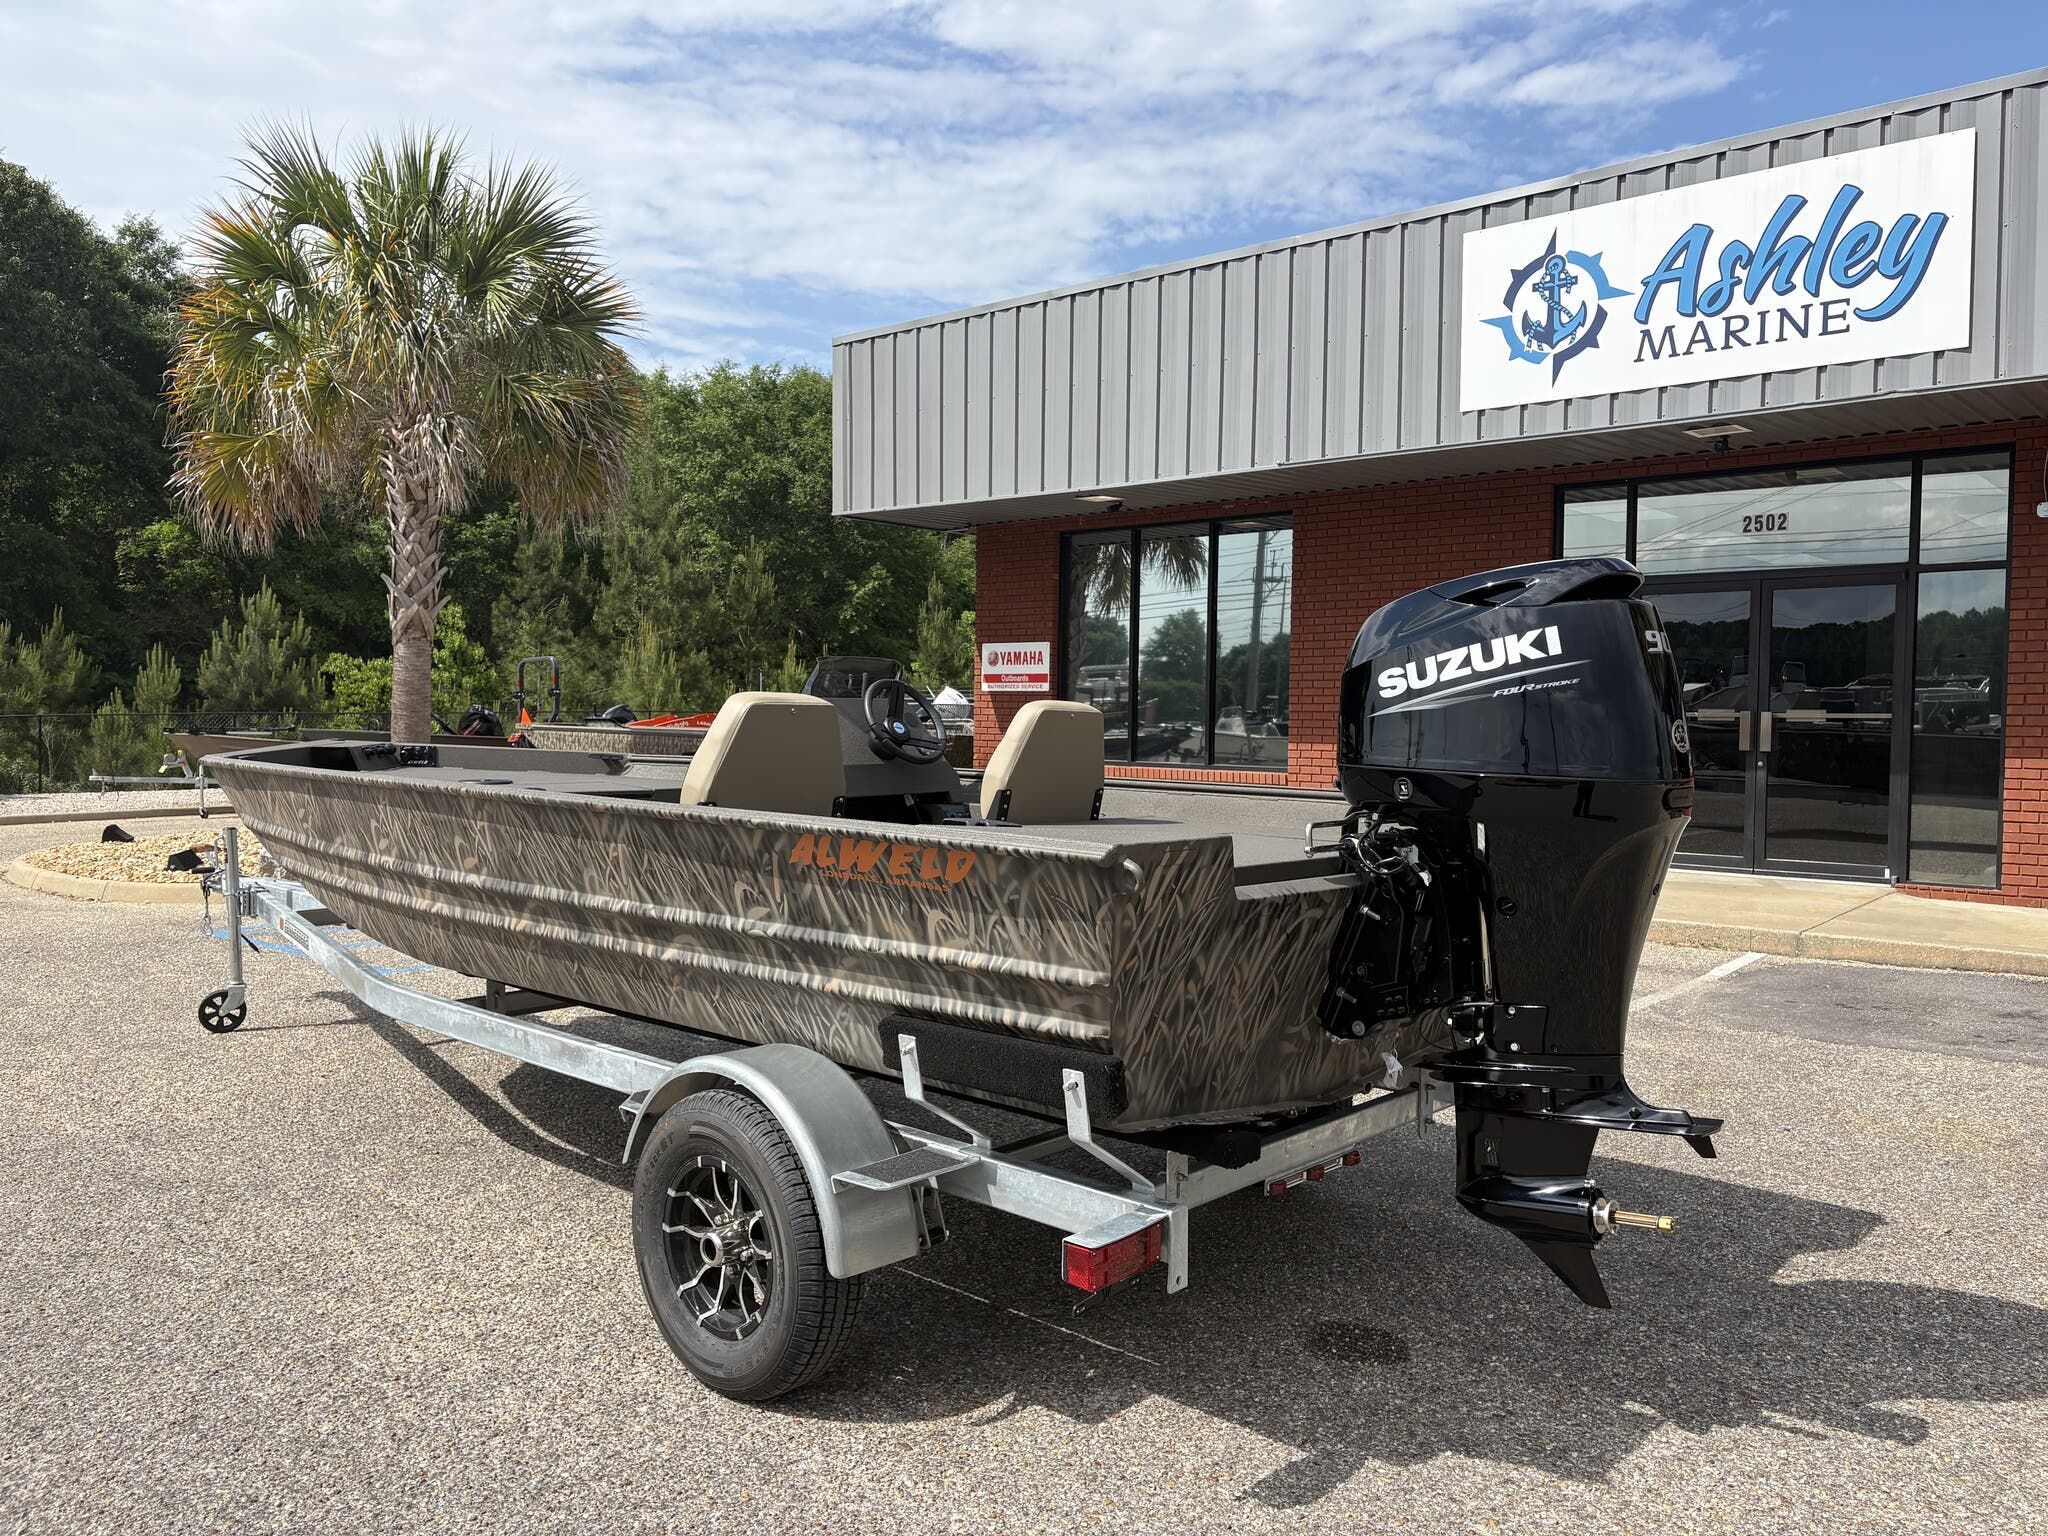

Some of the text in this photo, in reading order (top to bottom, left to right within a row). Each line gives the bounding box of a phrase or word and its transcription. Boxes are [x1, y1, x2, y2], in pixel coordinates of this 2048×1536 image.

[1634, 183, 1950, 322] Ashley
[1633, 297, 1851, 363] MARINE
[1742, 512, 1787, 533] 2502
[1000, 650, 1044, 666] YAMAHA
[1377, 625, 1563, 699] SUZUKI
[1492, 678, 1581, 698] FOUR STROKE
[789, 832, 977, 884] ALWELD
[886, 878, 951, 893] ARKANSAS
